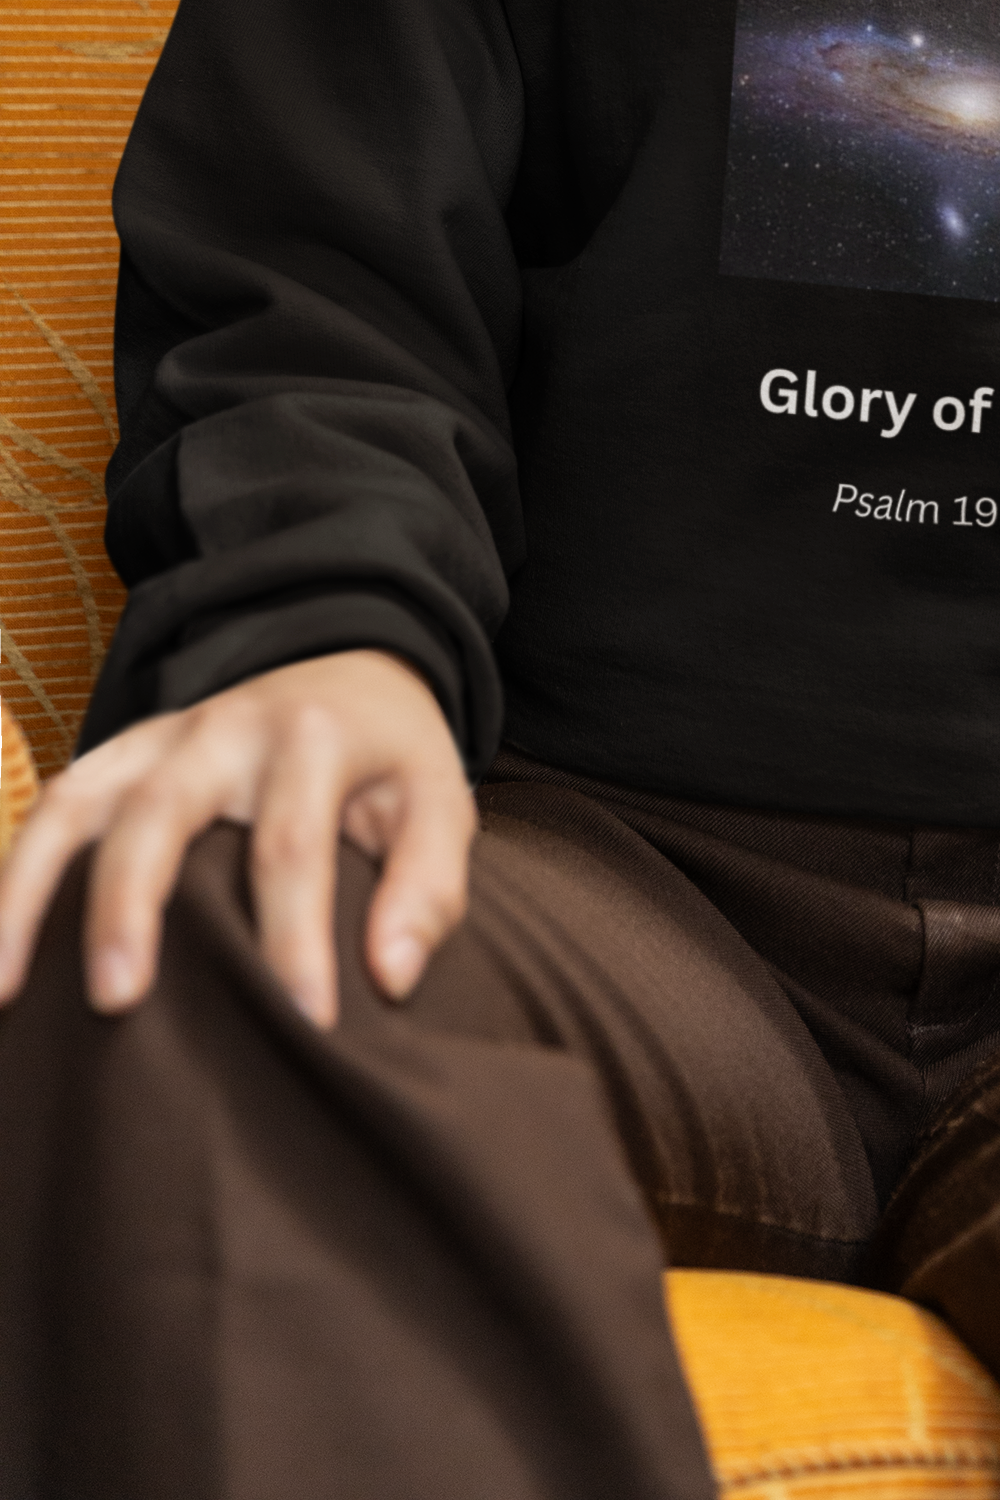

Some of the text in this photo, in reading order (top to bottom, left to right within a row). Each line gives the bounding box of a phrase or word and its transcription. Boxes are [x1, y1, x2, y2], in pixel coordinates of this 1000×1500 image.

[759, 368, 917, 438] Glory
[932, 387, 995, 433] of
[832, 483, 940, 524] Psalm
